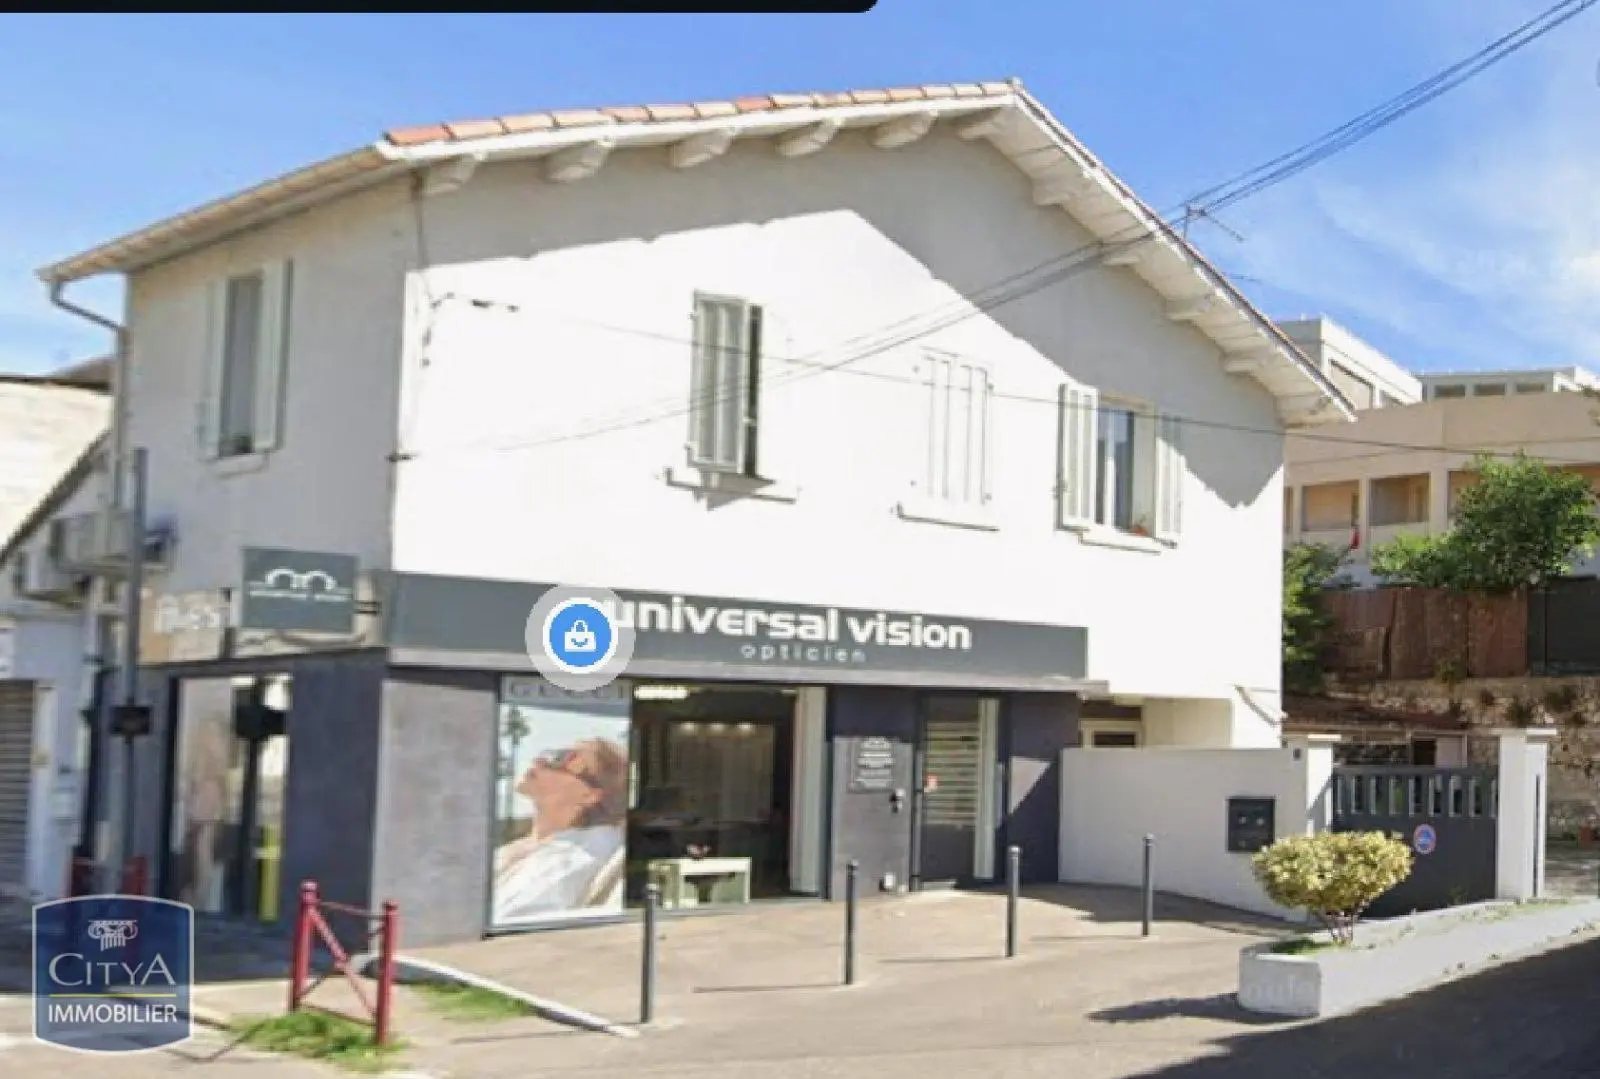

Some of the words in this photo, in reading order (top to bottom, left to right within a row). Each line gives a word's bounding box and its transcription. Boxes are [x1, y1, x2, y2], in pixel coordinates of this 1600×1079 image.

[602, 595, 839, 642] universal
[846, 612, 972, 651] vision
[740, 643, 867, 664] opticien
